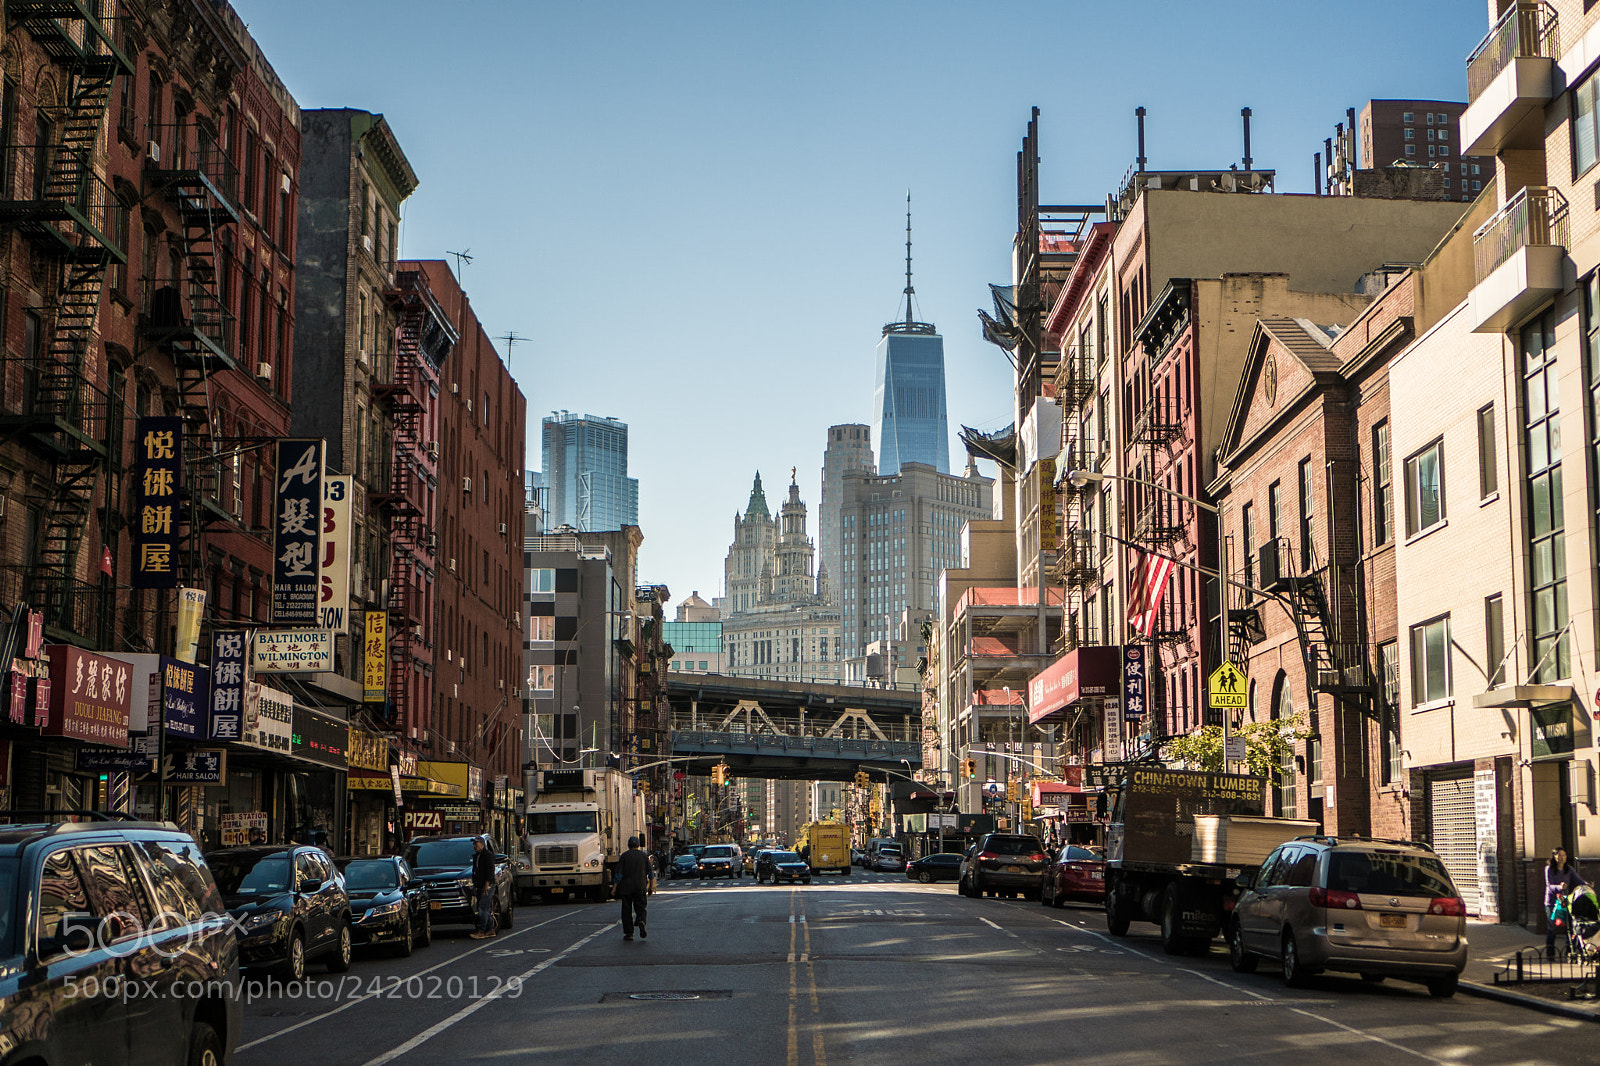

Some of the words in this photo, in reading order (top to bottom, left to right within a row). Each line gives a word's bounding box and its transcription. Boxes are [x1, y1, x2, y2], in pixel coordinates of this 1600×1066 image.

[259, 633, 327, 644] BALTIMORE
[258, 651, 329, 661] WILMINGTON
[1214, 696, 1242, 705] AHEAD
[74, 701, 95, 719] DUOLI
[96, 706, 122, 724] JIAFANG
[176, 772, 193, 780] HAIR
[195, 772, 220, 780] SALON
[1134, 771, 1207, 788] CHINATOWN
[1213, 776, 1260, 792] LUMBER
[239, 812, 267, 820] STATION
[404, 812, 441, 828] PIZZA
